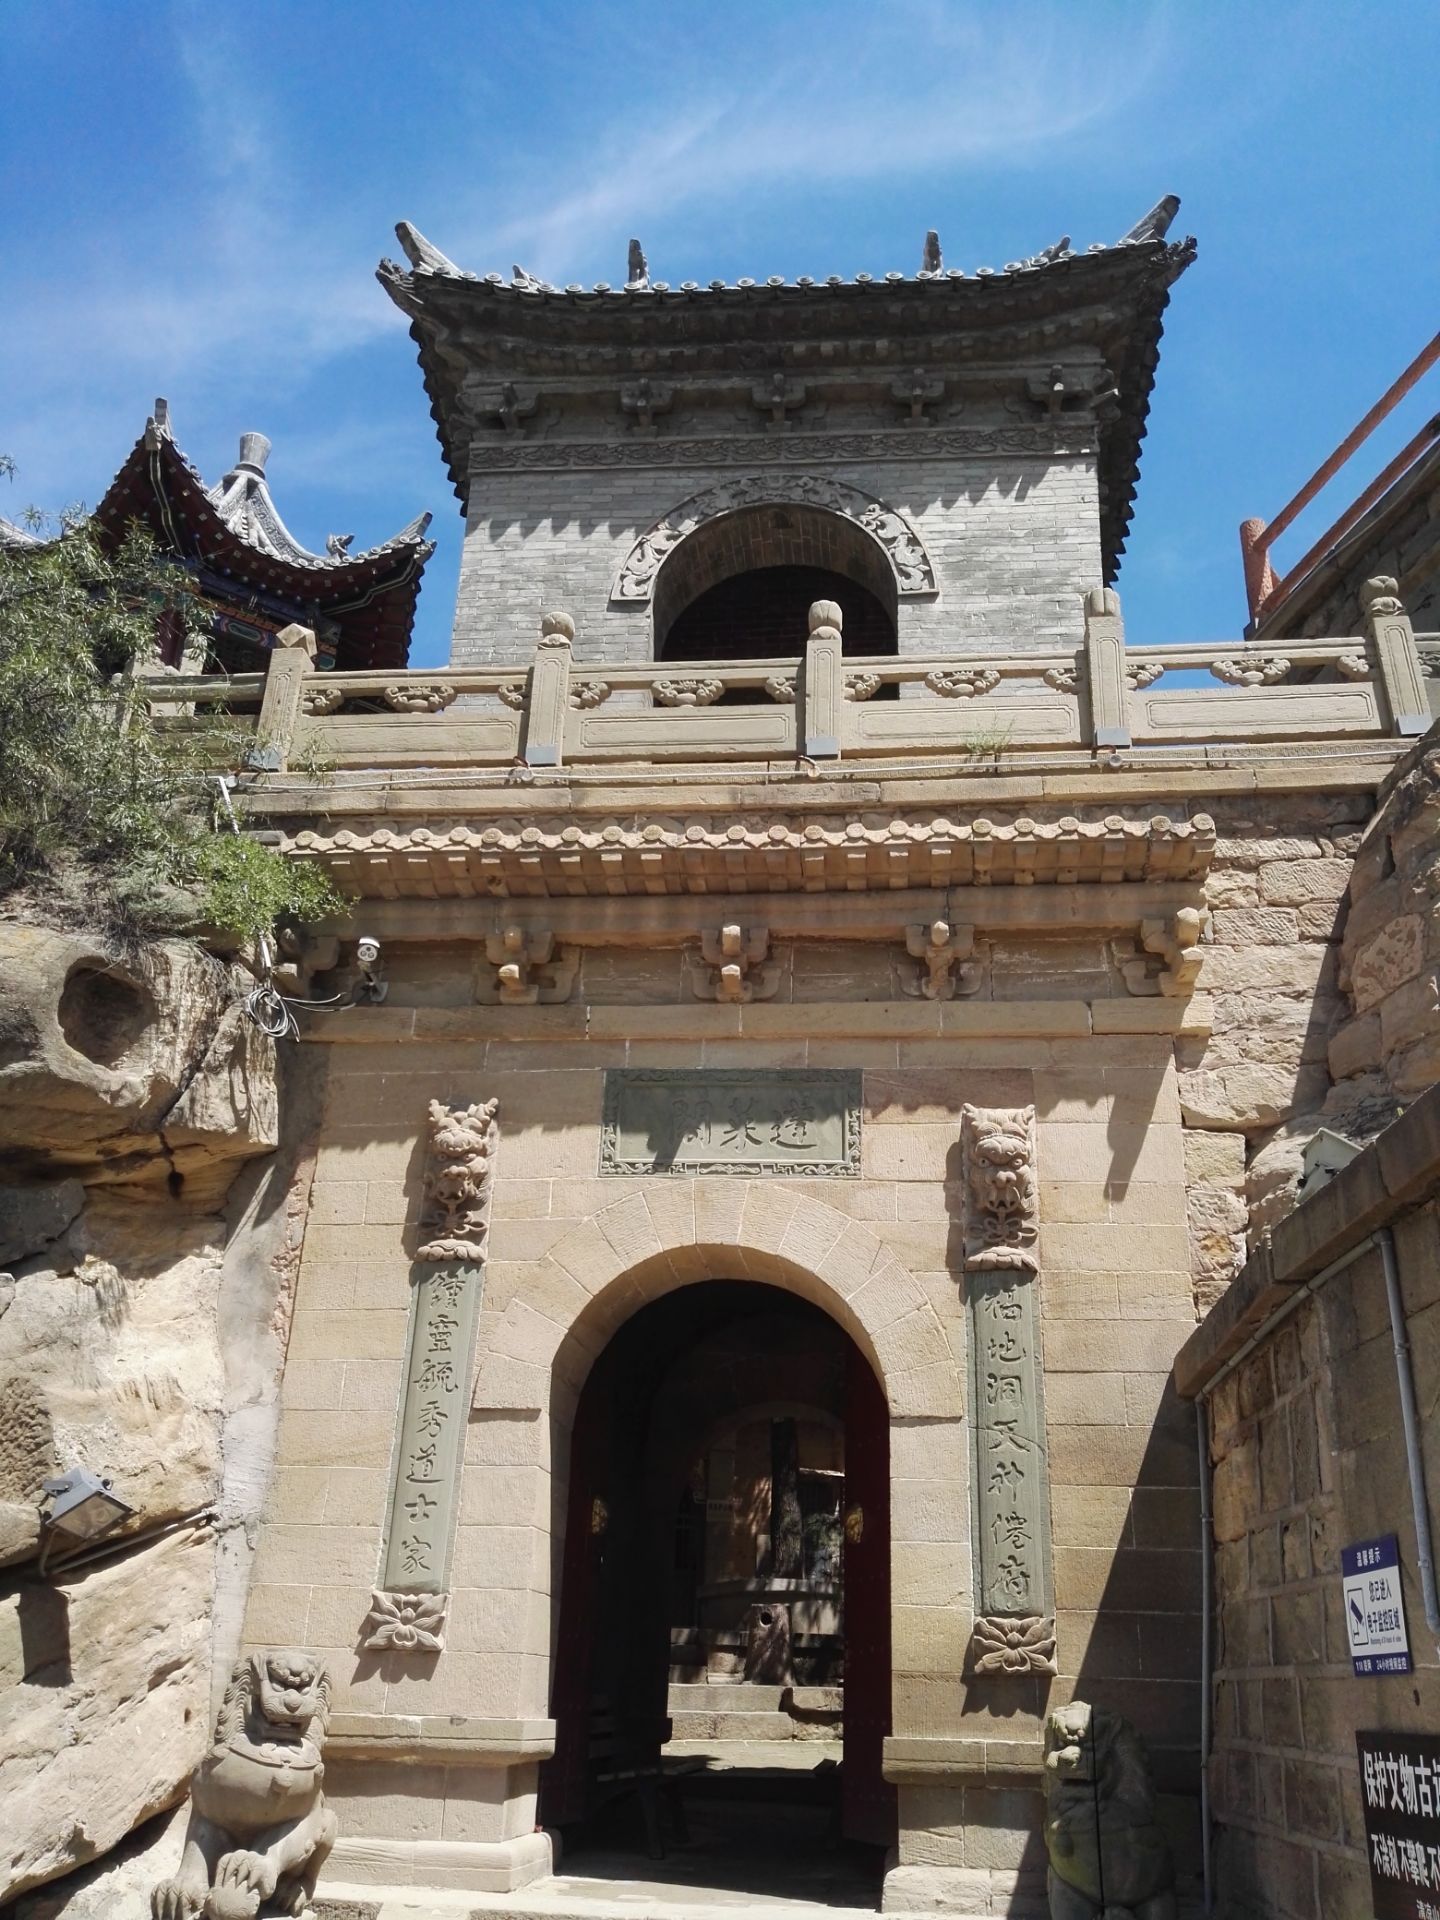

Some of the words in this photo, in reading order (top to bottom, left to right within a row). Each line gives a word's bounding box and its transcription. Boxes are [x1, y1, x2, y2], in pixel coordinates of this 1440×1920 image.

[1368, 1578, 1392, 1602] 您已进入
[1367, 1607, 1400, 1633] 电子监控区域
